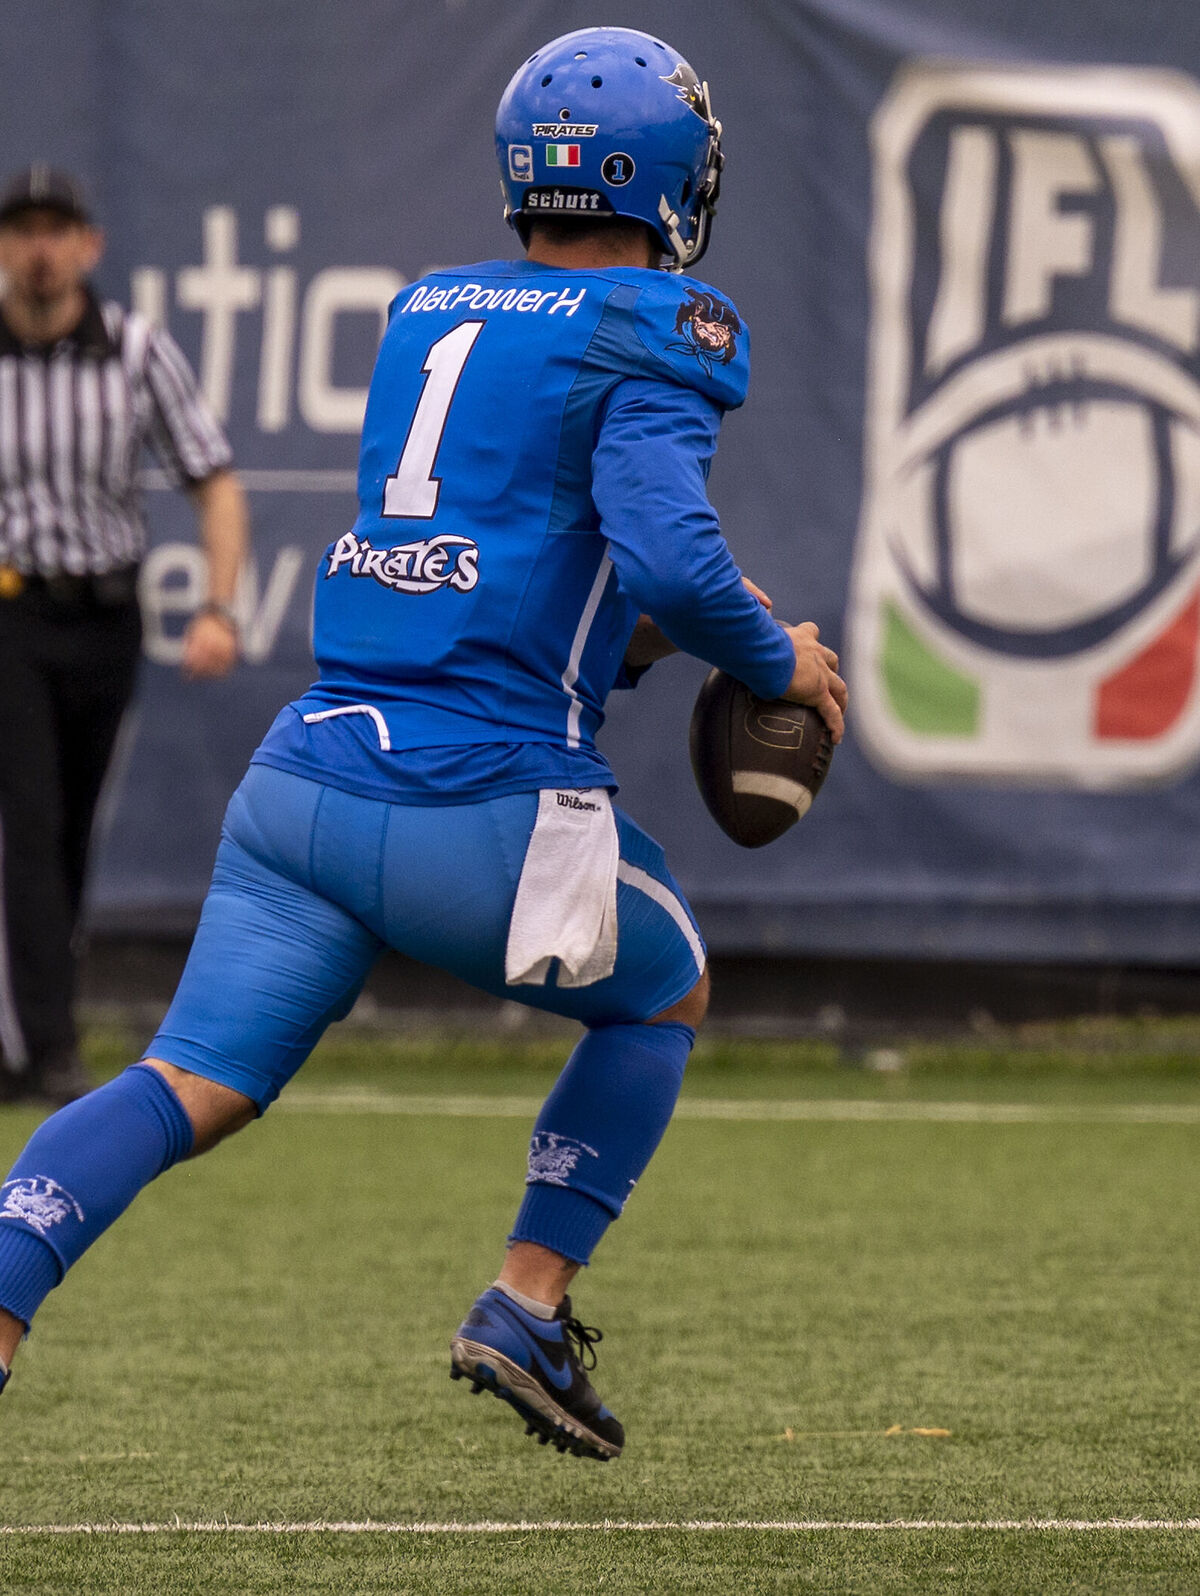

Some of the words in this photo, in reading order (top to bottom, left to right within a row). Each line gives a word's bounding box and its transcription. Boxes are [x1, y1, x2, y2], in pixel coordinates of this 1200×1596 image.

[532, 123, 599, 139] PIRATES
[510, 147, 531, 173] C
[611, 160, 626, 181] 1
[528, 190, 600, 210] schutt
[924, 123, 1200, 378] IFL
[381, 320, 487, 519] 1
[556, 792, 596, 812] Wilson
